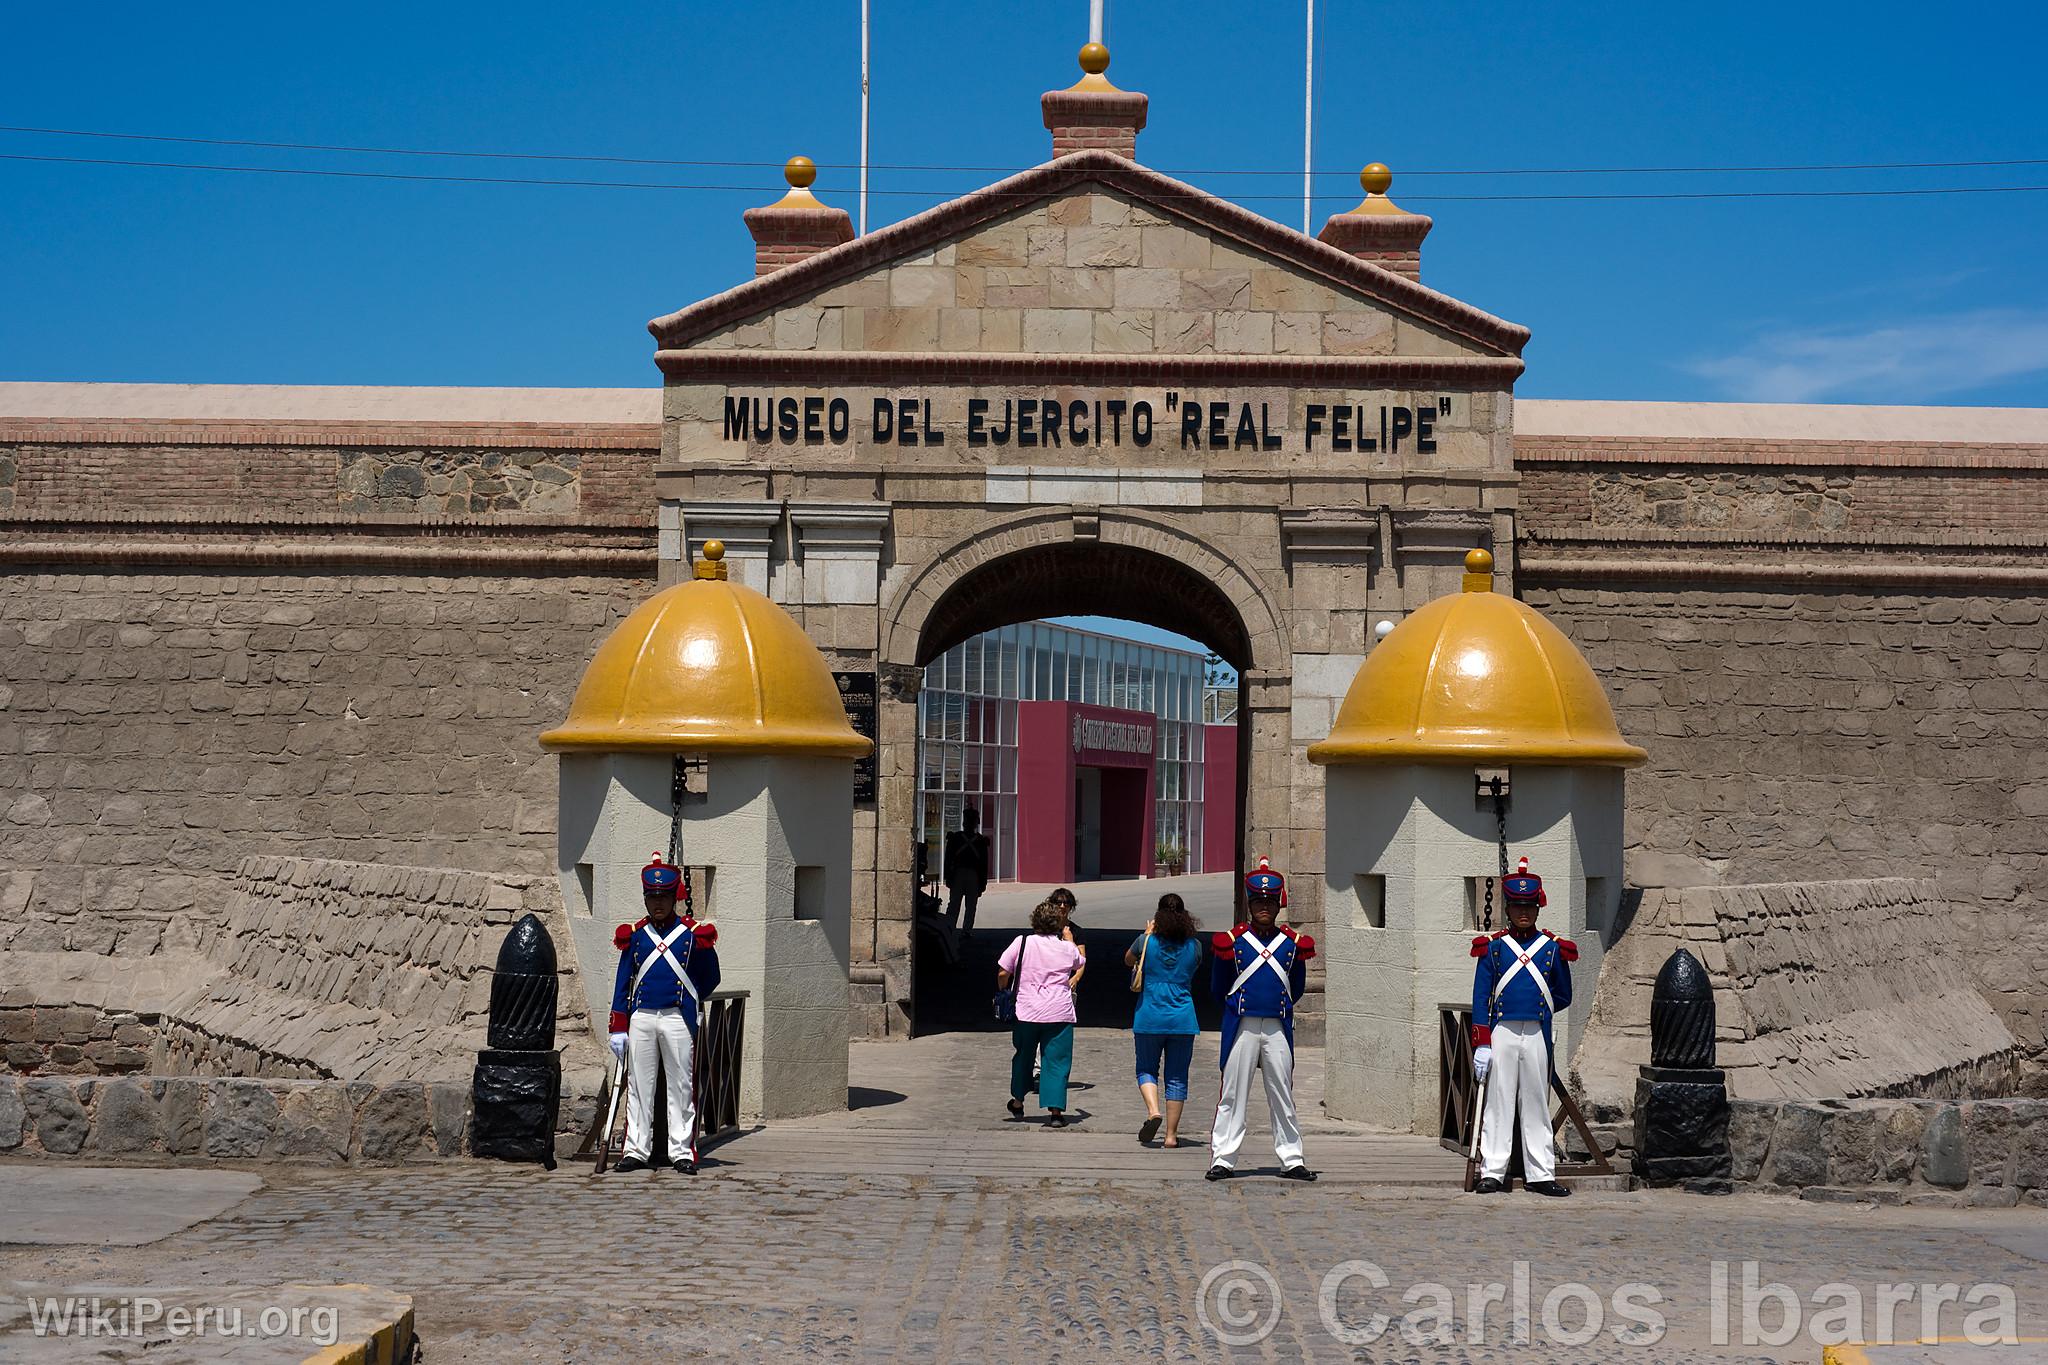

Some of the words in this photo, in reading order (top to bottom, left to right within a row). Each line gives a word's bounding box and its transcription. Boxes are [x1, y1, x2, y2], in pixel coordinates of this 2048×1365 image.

[724, 396, 849, 445] MUSEO
[873, 398, 944, 446] DEL
[967, 398, 1153, 448] EJERCITO
